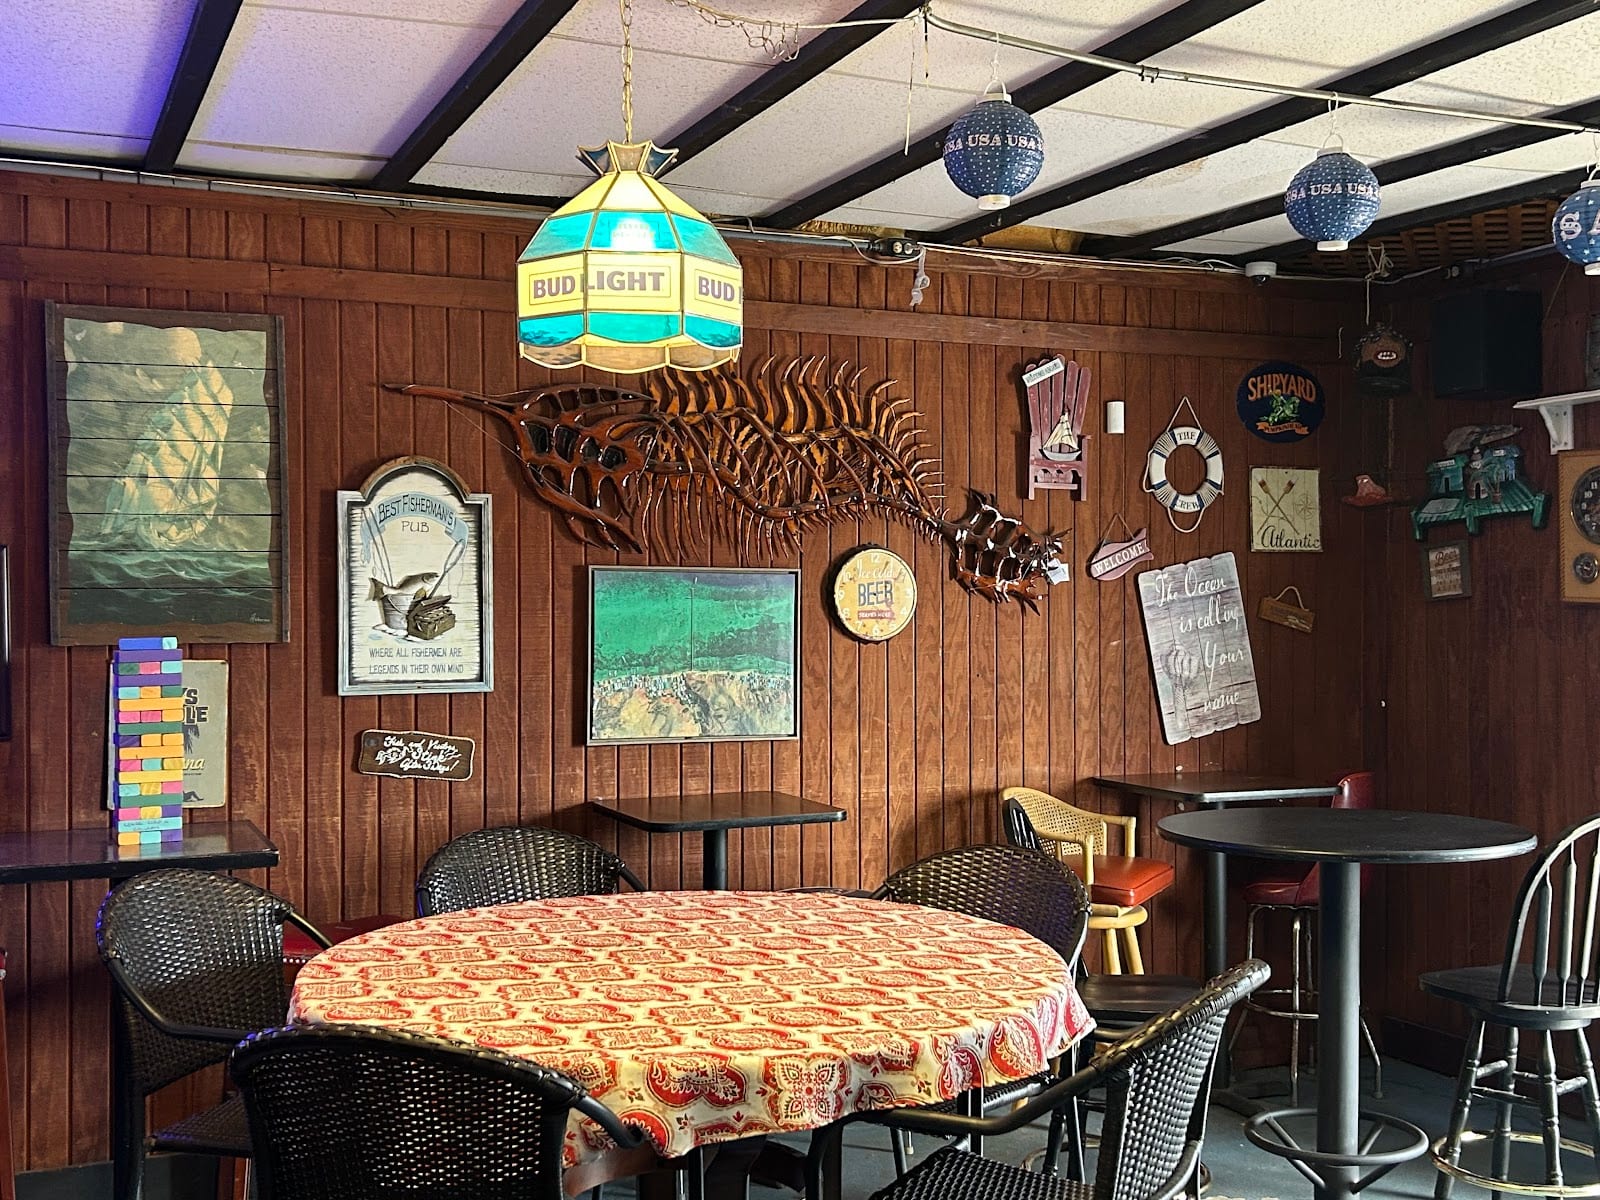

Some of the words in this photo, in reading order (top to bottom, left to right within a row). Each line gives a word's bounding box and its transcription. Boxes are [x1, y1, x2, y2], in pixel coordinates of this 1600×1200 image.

[968, 134, 1001, 147] USA
[1006, 134, 1036, 150] USA
[1310, 183, 1342, 195] USA
[1347, 183, 1373, 197] USA
[533, 275, 576, 299] BUD
[580, 270, 665, 293] LIGHT
[698, 275, 735, 301] BUD
[1248, 373, 1316, 402] SHIPYARD
[1177, 431, 1196, 441] THE
[378, 499, 402, 524] BEST
[402, 494, 454, 526] FISHERMAN'S
[402, 521, 430, 532] PUB
[1261, 525, 1319, 548] Atlantic
[1094, 543, 1145, 573] WELCOME
[858, 581, 893, 606] BEER
[1155, 572, 1178, 607] The
[1184, 566, 1226, 597] Ocean
[1179, 614, 1192, 633] is
[1197, 593, 1239, 631] calling
[369, 648, 393, 658] WHERE
[396, 648, 408, 658] ALL
[412, 647, 447, 658] FISHERMEN
[449, 647, 462, 657] ARE
[369, 664, 399, 674] LEGENDS
[401, 664, 408, 673] IN
[410, 664, 429, 673] THEIR
[431, 664, 446, 673] OWN
[447, 664, 464, 673] MIND
[1204, 640, 1244, 691] Your
[1203, 690, 1240, 713] name
[184, 706, 209, 724] LE
[183, 757, 206, 771] na
